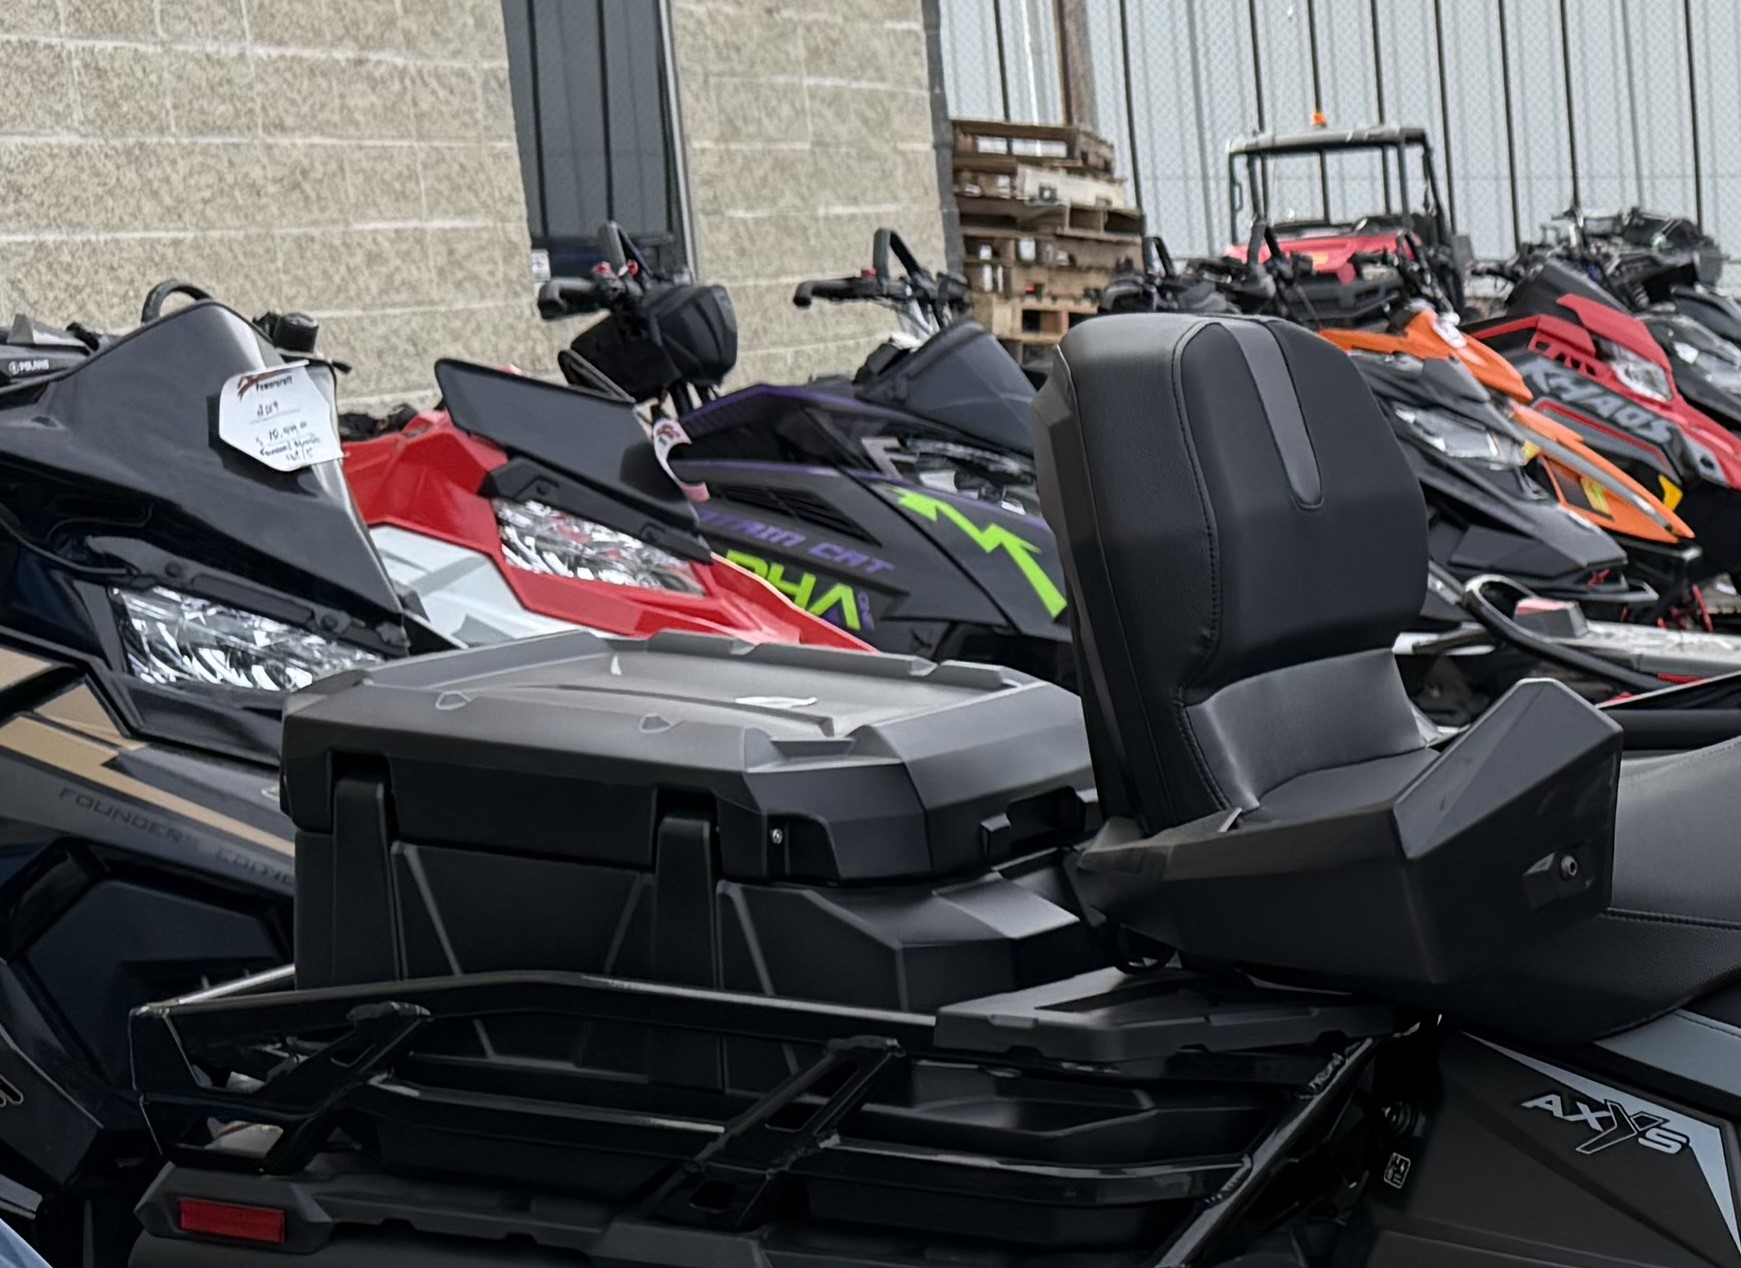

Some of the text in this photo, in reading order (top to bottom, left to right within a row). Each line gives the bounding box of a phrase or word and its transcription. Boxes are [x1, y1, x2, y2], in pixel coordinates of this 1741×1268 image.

[1518, 357, 1675, 444] KHAOS
[808, 542, 895, 573] CAT
[1520, 1093, 1688, 1155] AXYS
